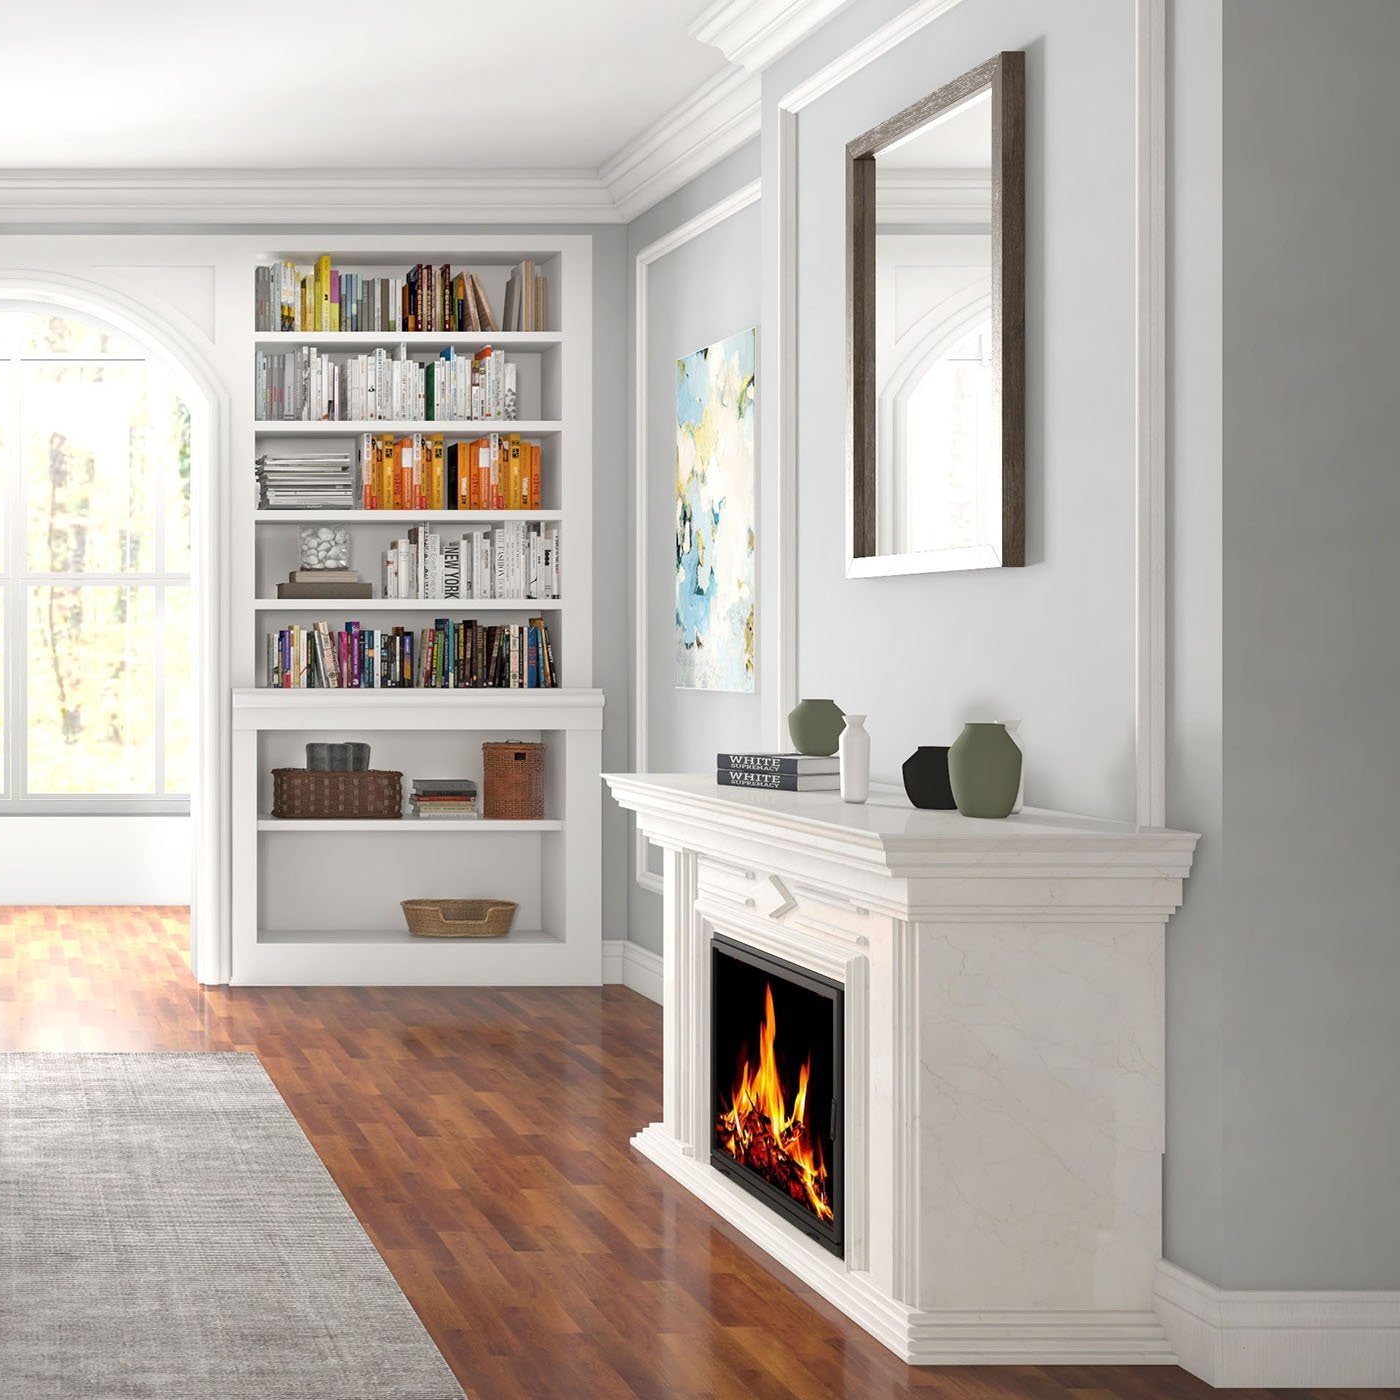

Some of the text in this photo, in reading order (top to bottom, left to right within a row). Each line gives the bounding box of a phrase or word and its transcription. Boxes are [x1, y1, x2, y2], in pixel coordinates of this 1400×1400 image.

[497, 545, 505, 577] FASHION
[444, 547, 459, 599] NEW YORK
[730, 756, 780, 767] WHITE
[731, 764, 779, 772] SUPREMACY
[730, 772, 780, 783] WHITE
[731, 780, 779, 788] SUPREMACY
